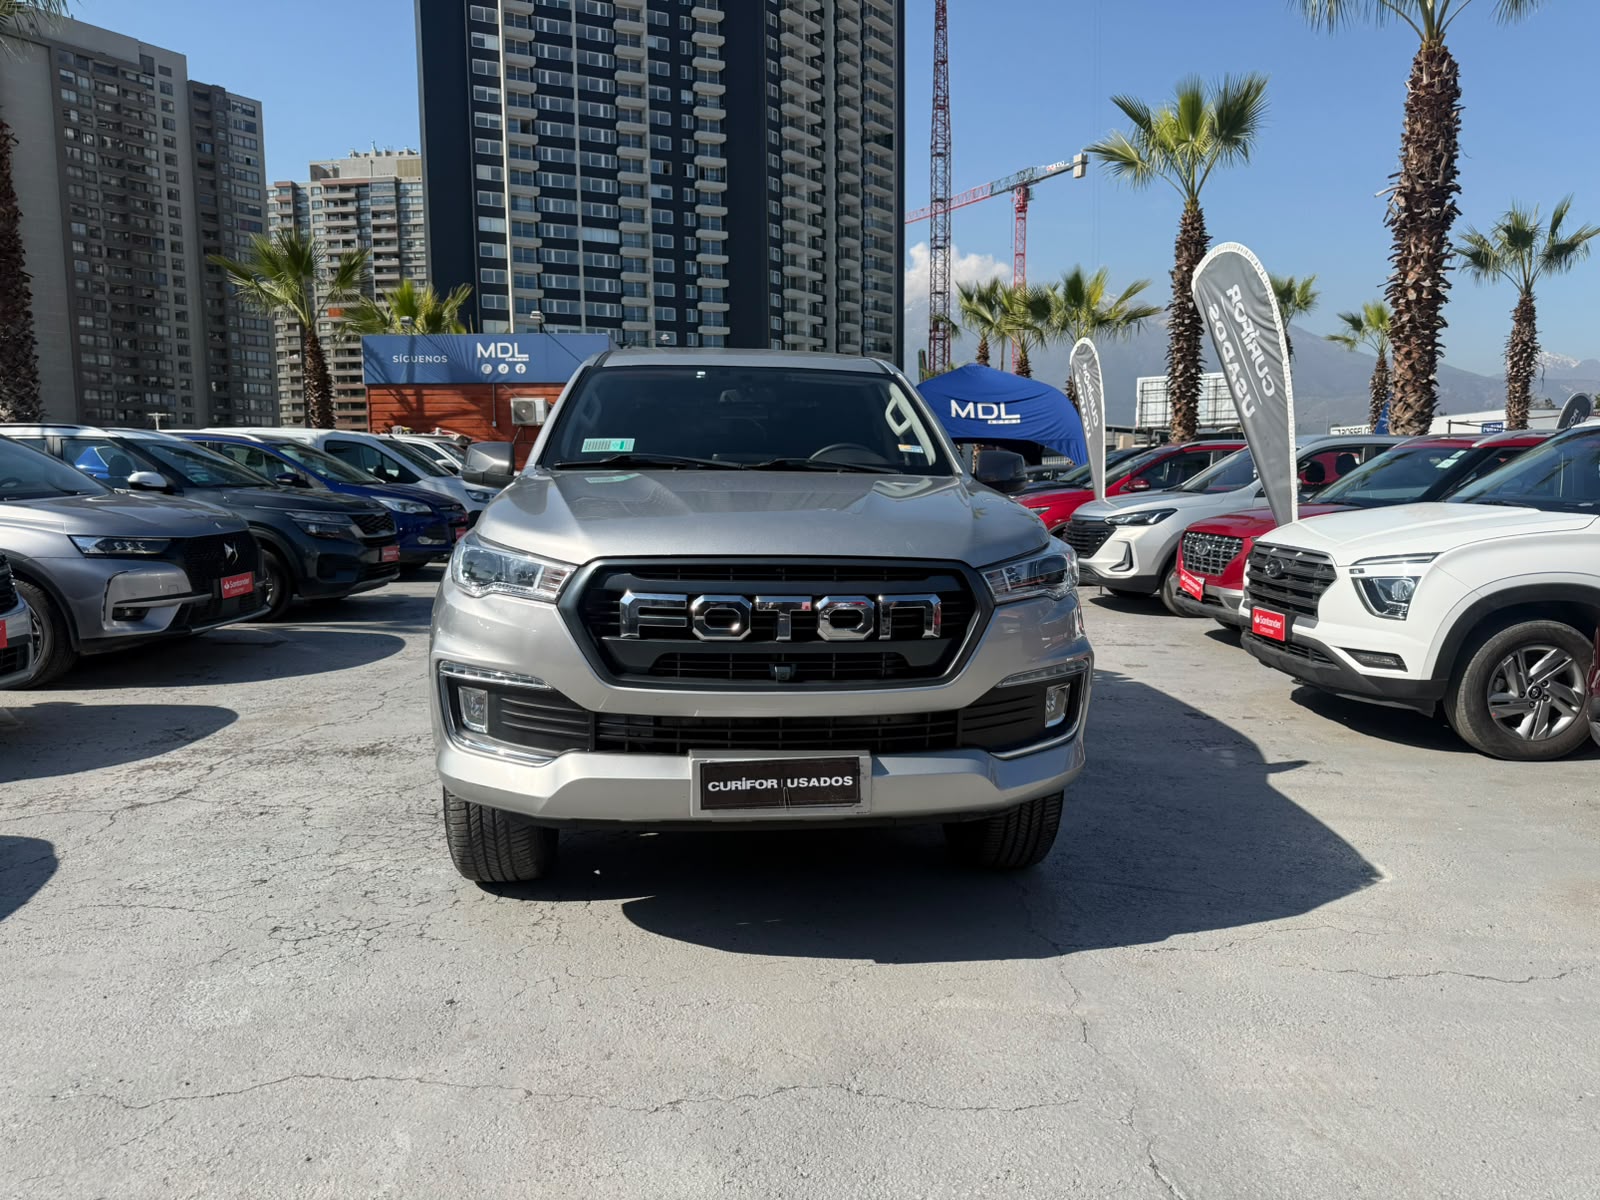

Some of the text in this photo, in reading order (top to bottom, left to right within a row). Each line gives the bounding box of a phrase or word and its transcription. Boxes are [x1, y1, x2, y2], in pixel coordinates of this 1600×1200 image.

[476, 342, 529, 358] MDL
[392, 355, 448, 363] SÍGUENOS
[950, 399, 1021, 419] MDL
[620, 594, 941, 641] FOTON
[1259, 615, 1282, 629] Santander
[786, 776, 853, 788] USADOS
